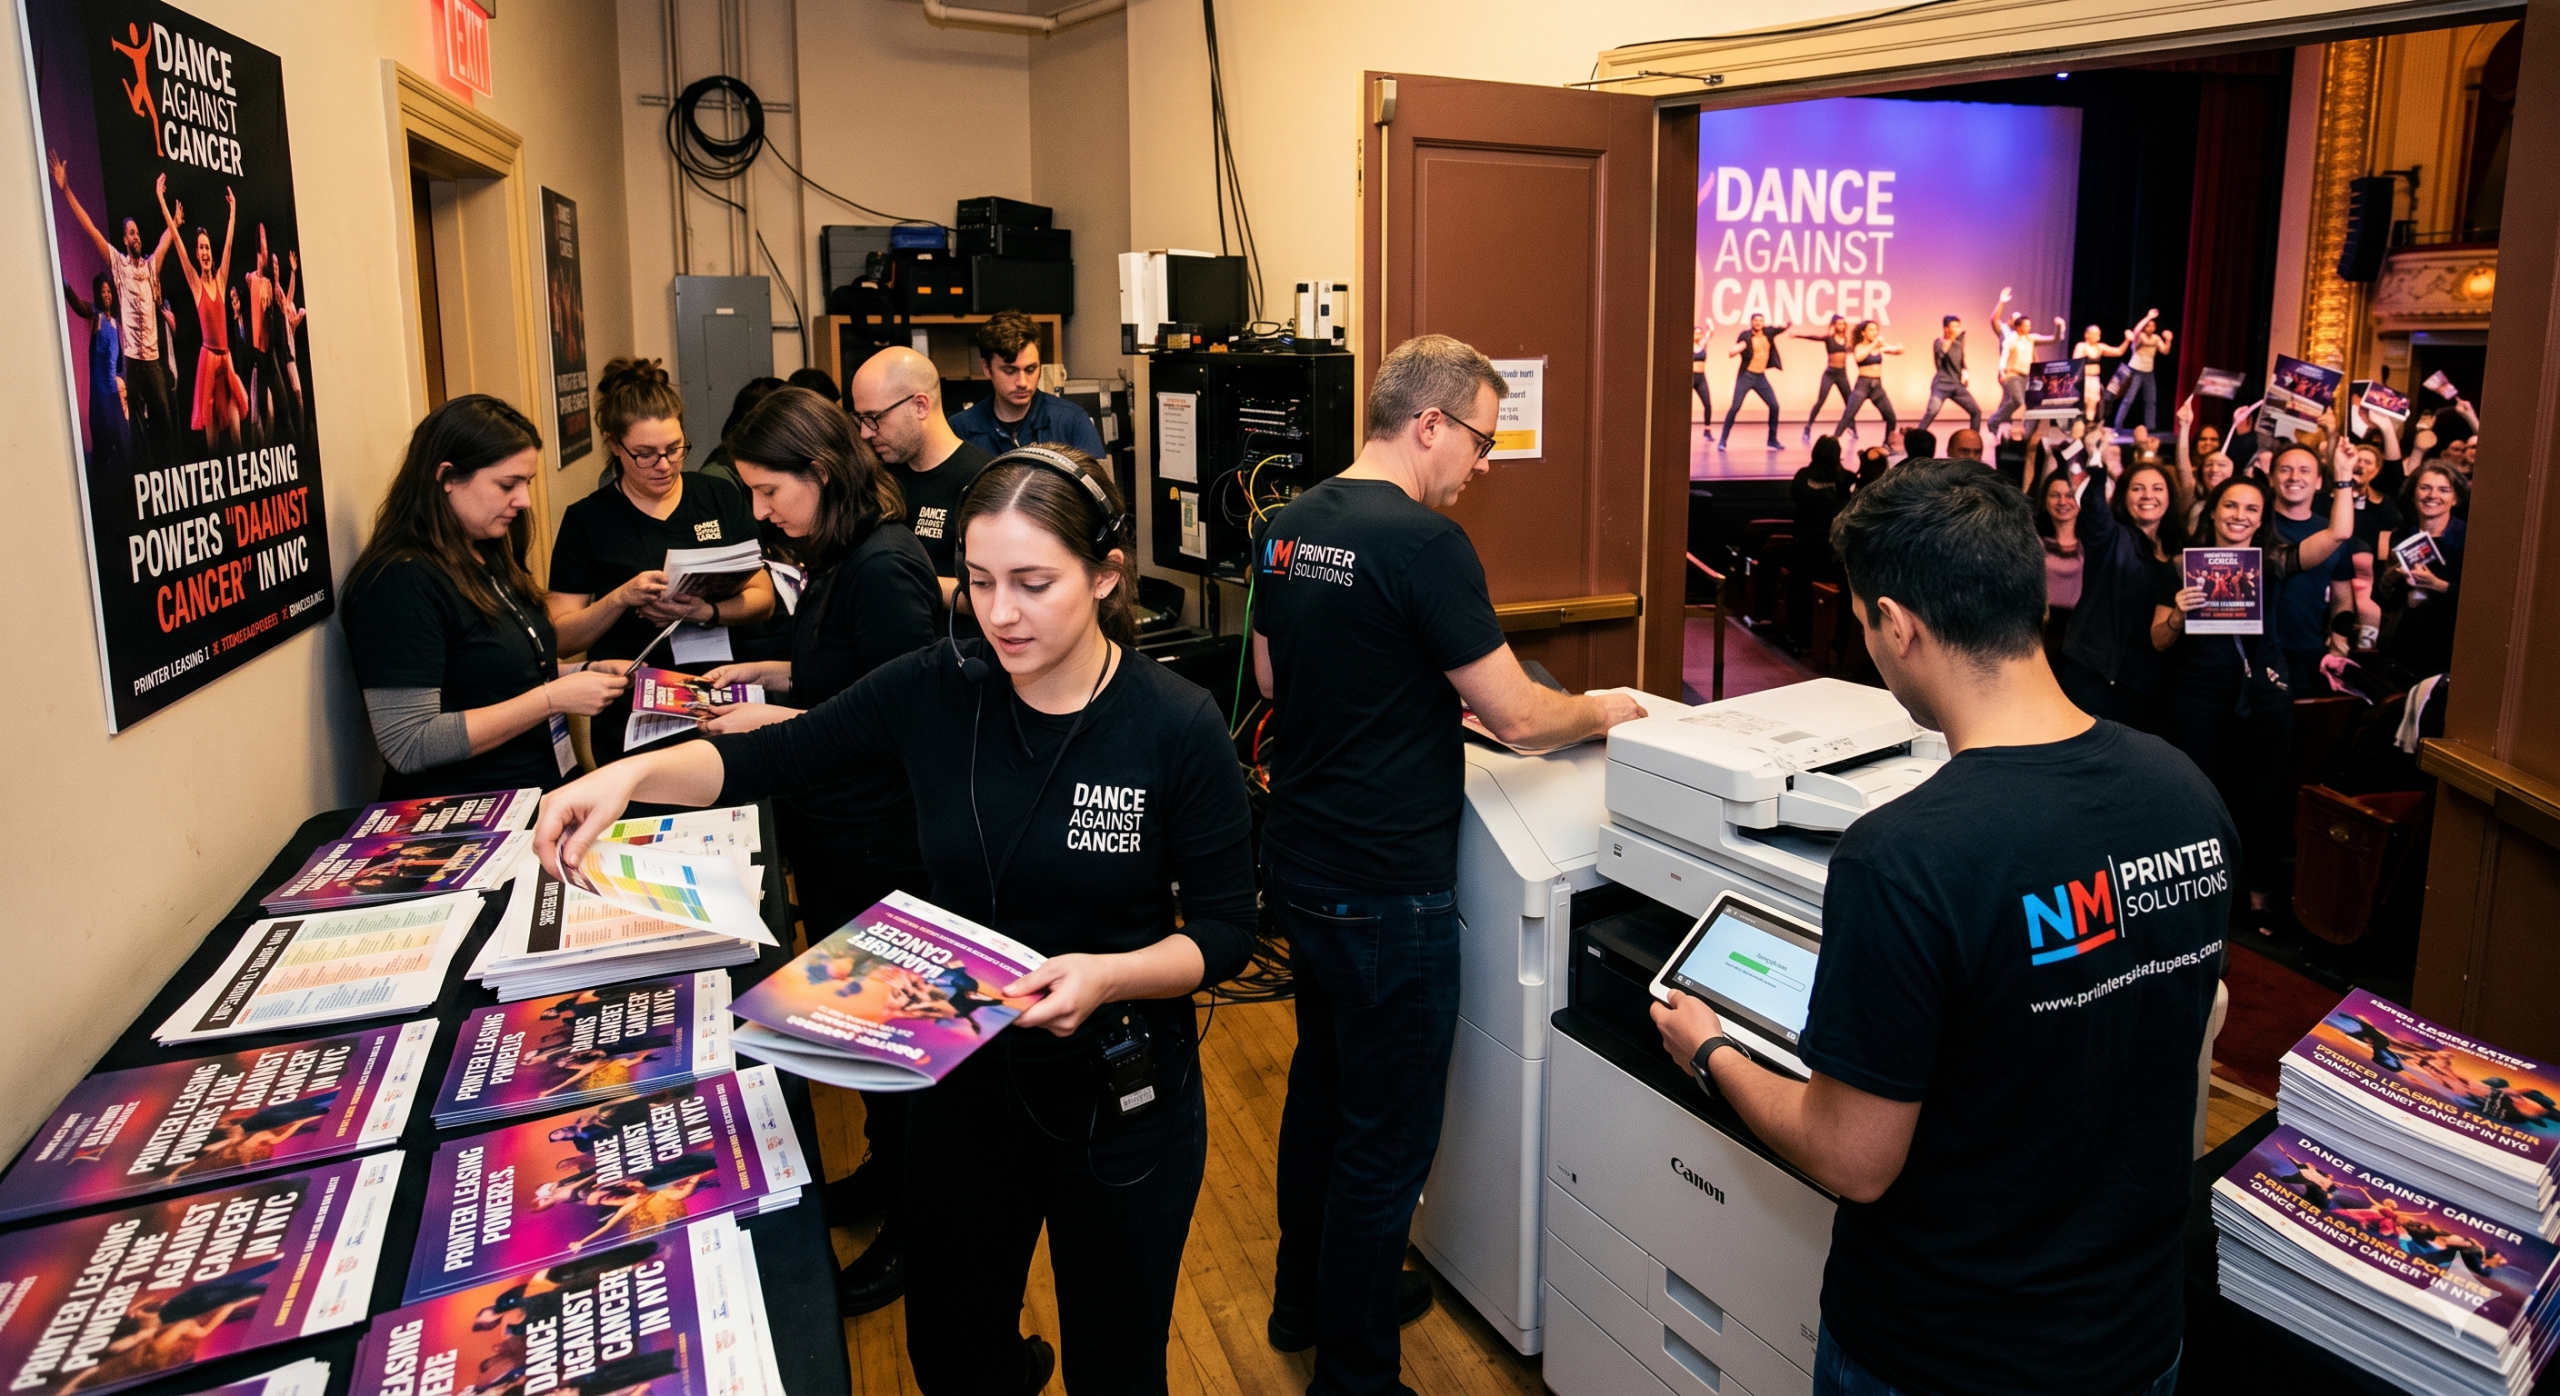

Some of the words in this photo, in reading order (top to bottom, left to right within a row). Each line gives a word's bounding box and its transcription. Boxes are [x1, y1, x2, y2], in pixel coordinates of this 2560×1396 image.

[153, 22, 237, 97] DANCE
[453, 0, 484, 88] EXIT
[162, 78, 237, 135] AGAINST
[164, 120, 244, 177] CANCER
[1716, 166, 1896, 225] DANCE
[1714, 228, 1894, 275] AGAINST
[1711, 278, 1892, 326] CANCER
[134, 458, 226, 520] PRINTER
[226, 443, 298, 496] LEASING
[129, 512, 223, 584] POWERS
[1263, 538, 1294, 567] NM
[1297, 543, 1356, 569] PRINTER
[157, 555, 252, 633] CANCER"
[257, 548, 276, 591] IN
[278, 535, 308, 582] NYC
[1294, 562, 1354, 587] SOLUTIONS
[133, 666, 170, 696] PRINTER
[170, 649, 204, 678] LEASING
[1068, 808, 1143, 831] AGAINST
[1073, 782, 1146, 812] DANCE
[1067, 829, 1141, 853] CANCER
[2022, 869, 2115, 949] NM
[2119, 838, 2223, 890] PRINTER
[2126, 870, 2228, 917] SOLUTIONS
[866, 921, 953, 965] CANCER
[653, 989, 676, 1013] NYC
[472, 1013, 505, 1055] LEASING
[306, 1075, 339, 1092] IN
[315, 1046, 351, 1074] NYC
[454, 1055, 492, 1101] PRINTER
[126, 1114, 190, 1175] PRINTER
[168, 1064, 221, 1116] LEASING
[680, 1096, 708, 1126] NYC
[687, 1125, 713, 1144] IN
[2480, 1127, 2497, 1140] IN
[453, 1146, 484, 1205] LEASING
[1671, 1157, 1724, 1205] Canon
[254, 1191, 298, 1234] NYC
[2357, 1172, 2439, 1210] AGAINST
[2442, 1203, 2523, 1246] CANCER
[147, 1201, 221, 1291] AGAINST
[242, 1235, 282, 1259] IN
[443, 1203, 479, 1273] PRINTER
[10, 1297, 96, 1391] PRINTER
[69, 1219, 141, 1297] LEASING
[635, 1260, 668, 1308] NYC
[2429, 1276, 2448, 1291] IN
[639, 1307, 671, 1336] IN
[378, 1319, 424, 1396] EASING
[524, 1316, 558, 1396] DANCE
